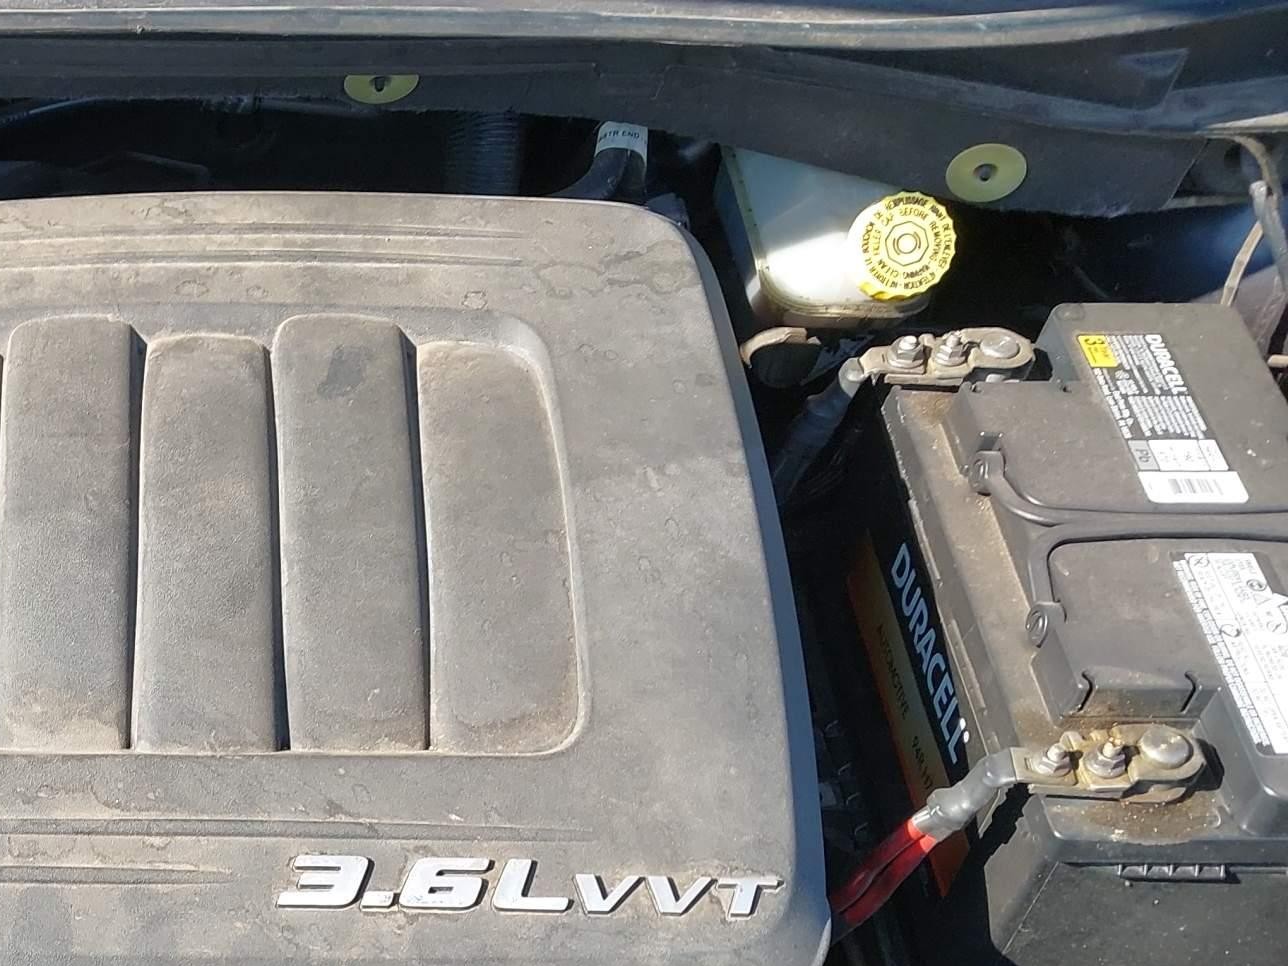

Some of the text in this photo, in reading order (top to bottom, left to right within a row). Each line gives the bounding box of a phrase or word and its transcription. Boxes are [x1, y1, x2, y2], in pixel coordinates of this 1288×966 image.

[1144, 334, 1188, 395] DURACELL
[1135, 449, 1149, 463] Pb
[890, 542, 959, 765] DURACELL
